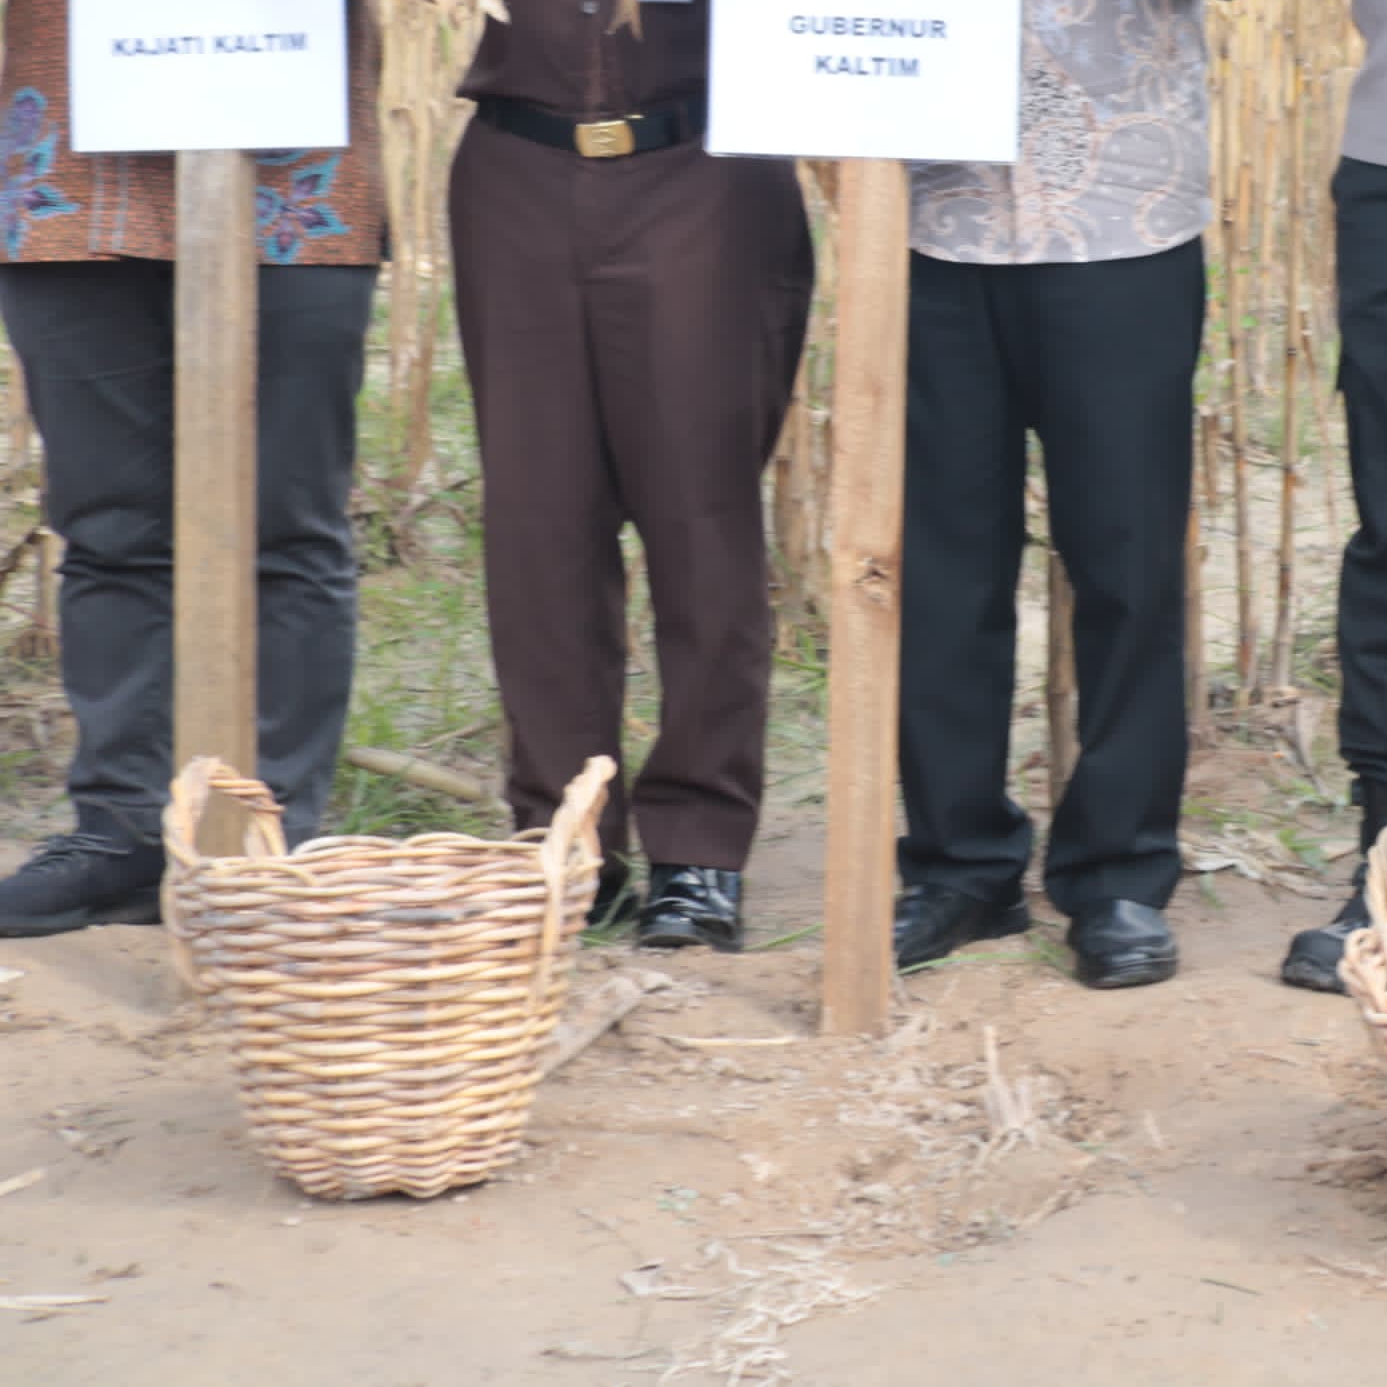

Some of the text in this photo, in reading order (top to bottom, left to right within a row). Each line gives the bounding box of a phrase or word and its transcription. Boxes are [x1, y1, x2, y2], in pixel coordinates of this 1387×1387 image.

[790, 15, 947, 39] GUBERNUR
[112, 32, 308, 57] KAJATI KALTIM
[815, 56, 920, 77] KALTIM
